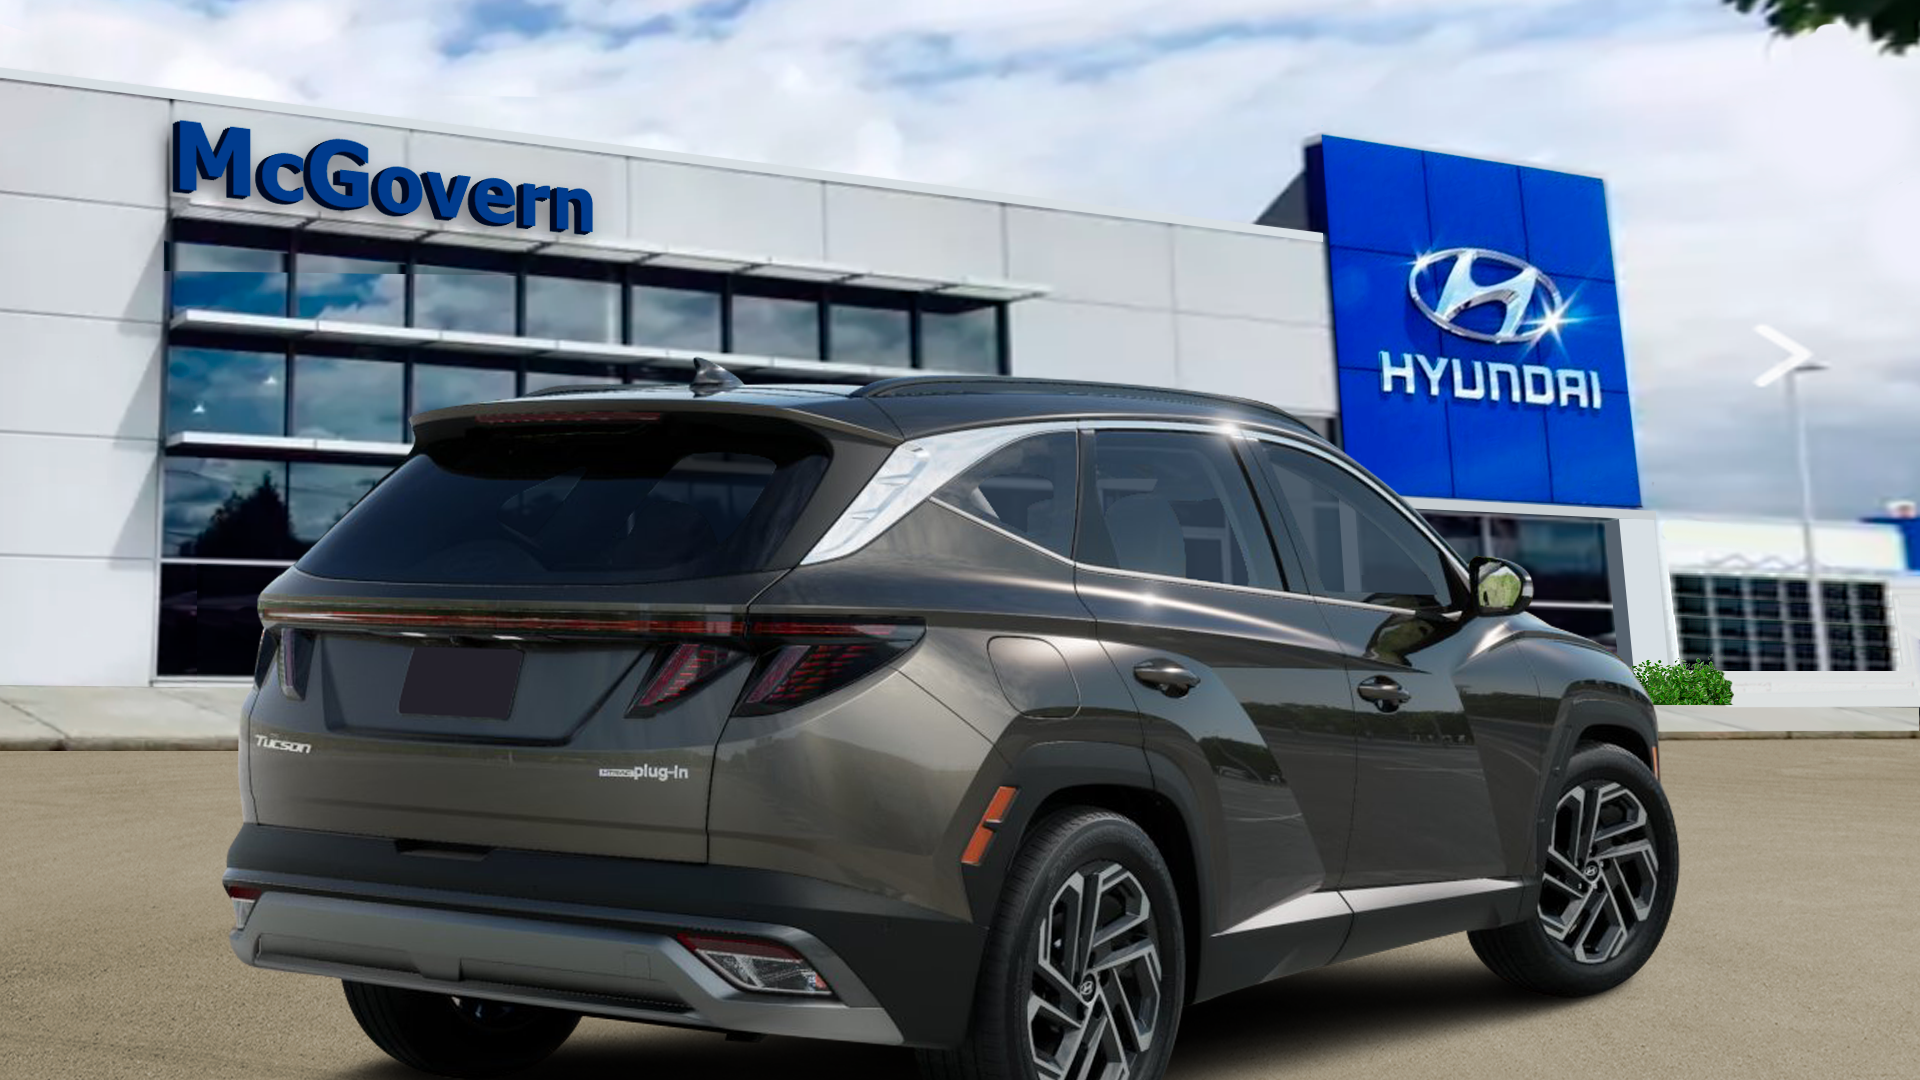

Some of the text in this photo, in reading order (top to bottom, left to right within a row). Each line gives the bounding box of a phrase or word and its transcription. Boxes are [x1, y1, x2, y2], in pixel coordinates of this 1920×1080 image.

[171, 119, 594, 236] McGovern
[1379, 350, 1602, 409] HYUNDAI
[634, 763, 689, 781] plug-in
